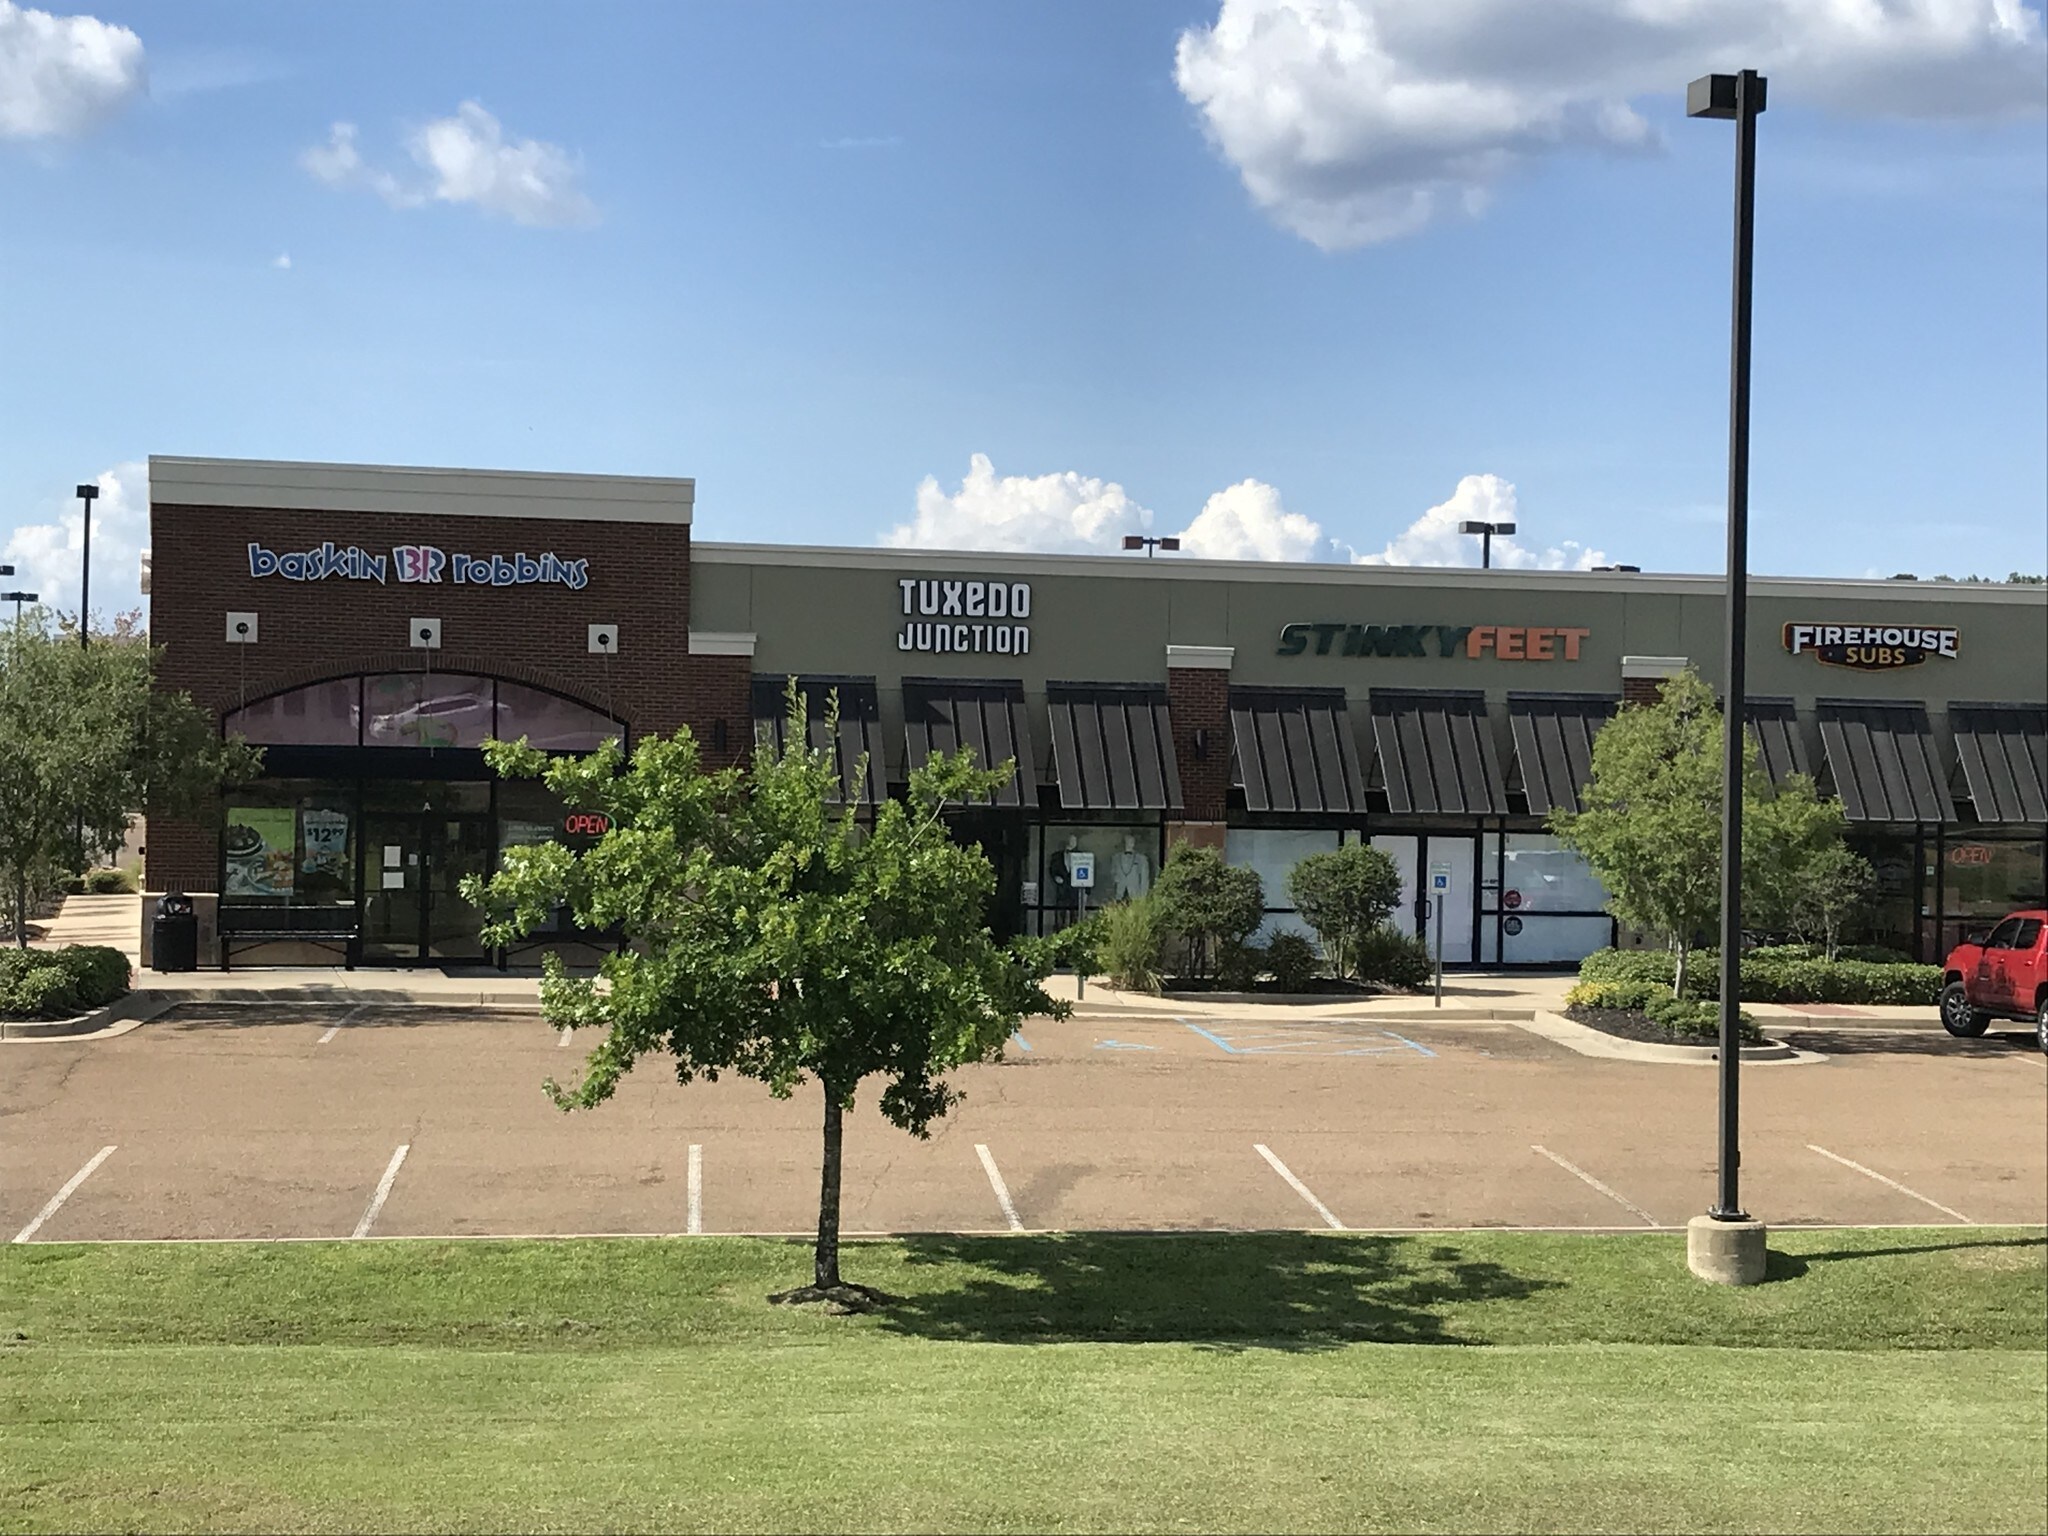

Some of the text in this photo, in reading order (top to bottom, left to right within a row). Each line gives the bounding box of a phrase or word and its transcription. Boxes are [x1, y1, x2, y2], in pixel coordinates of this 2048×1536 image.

[248, 542, 589, 590] baskin BR robbins
[898, 622, 1029, 656] JUNCTION
[1793, 625, 1958, 660] FIREHOUSE
[1846, 647, 1906, 664] SUBS
[565, 815, 609, 834] OPEN
[1951, 846, 1993, 864] OPEN
